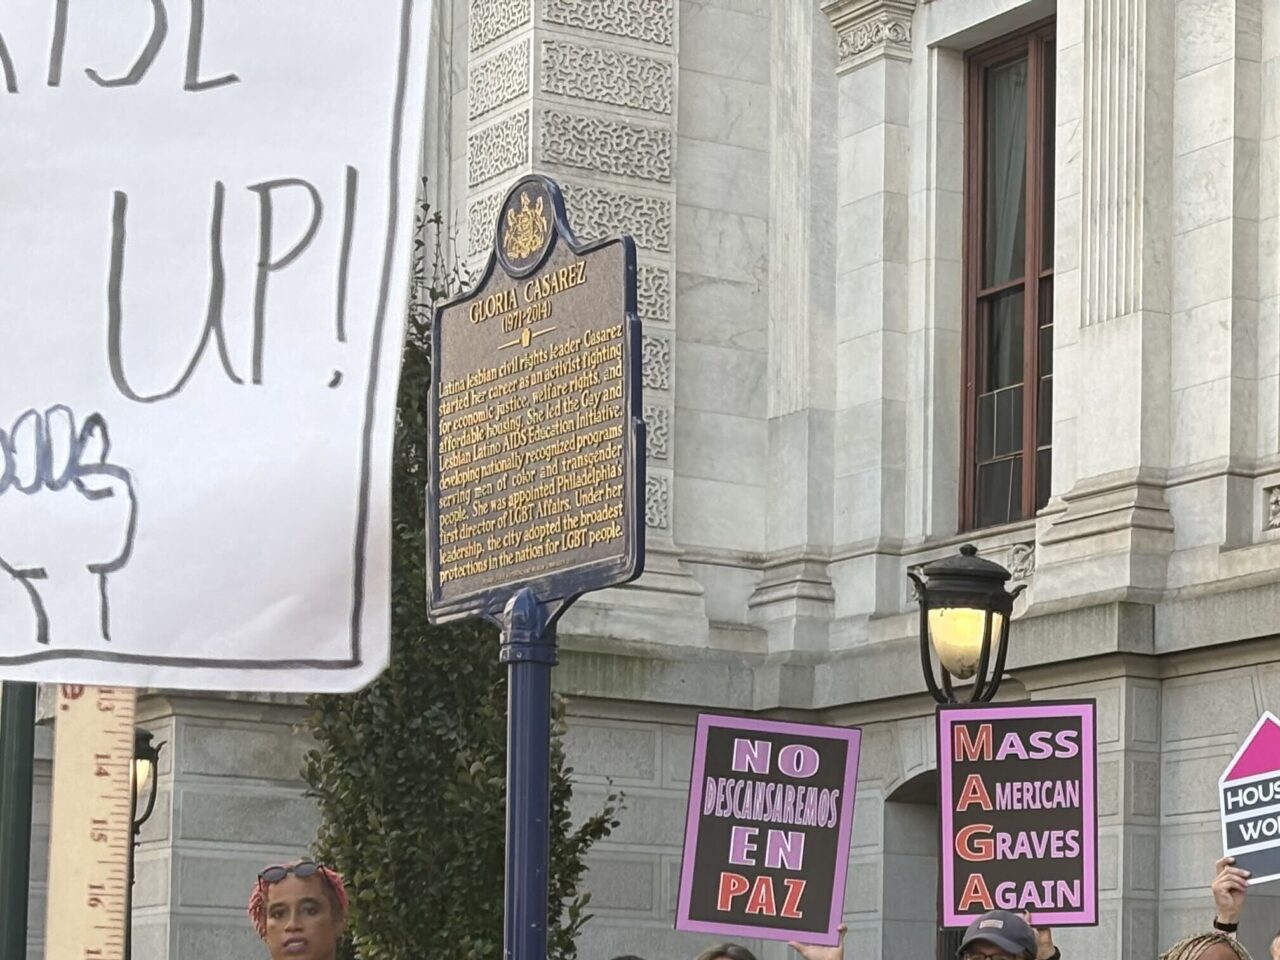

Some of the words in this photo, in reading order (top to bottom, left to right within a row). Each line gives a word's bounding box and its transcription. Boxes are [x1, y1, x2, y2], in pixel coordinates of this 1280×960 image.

[107, 164, 358, 403] UP!
[469, 288, 519, 324] GLORIA
[524, 261, 587, 303] CASAREZ
[439, 378, 465, 399] Latina
[467, 367, 497, 389] lesbian
[499, 355, 518, 378] civil
[519, 346, 548, 372] rights
[550, 336, 581, 361] leader
[584, 323, 622, 349] Casarez
[439, 391, 469, 417] started
[471, 388, 487, 406] her
[489, 378, 519, 400] career
[520, 375, 529, 390] as
[531, 370, 543, 386] an
[545, 352, 581, 382] activist
[583, 343, 622, 370] fighting
[439, 418, 452, 436] for
[453, 406, 494, 431] economic
[533, 382, 568, 406] welfare
[604, 359, 622, 383] and
[439, 425, 486, 454] affordable
[527, 406, 544, 427] She
[546, 399, 561, 421] led
[563, 395, 580, 416] the
[581, 390, 602, 410] Gay
[603, 379, 622, 403] and
[439, 450, 471, 472] Lesbian
[473, 441, 502, 462] Latino
[503, 429, 527, 453] AIDS
[529, 419, 575, 445] Education
[439, 465, 480, 489] developing
[481, 449, 525, 477] nationally
[526, 432, 576, 464] recognized
[577, 423, 623, 453] programs
[439, 488, 471, 509] serving
[474, 482, 493, 499] men
[497, 473, 508, 492] of
[512, 467, 536, 488] color
[540, 458, 558, 480] and
[562, 443, 623, 474] transgender
[472, 498, 489, 517] She
[490, 496, 507, 513] was
[508, 478, 555, 510] appointed
[440, 523, 460, 545] first
[460, 516, 496, 539] director
[497, 510, 509, 530] of
[509, 503, 535, 527] LGBT
[575, 487, 605, 510] Under
[606, 482, 623, 501] her
[487, 534, 502, 552] the
[503, 528, 523, 549] city
[524, 517, 561, 543] adopted
[563, 513, 580, 533] the
[580, 501, 623, 529] broadest
[440, 558, 488, 586] protections
[489, 556, 498, 570] in
[498, 549, 514, 568] the
[515, 544, 544, 564] nation
[545, 538, 560, 556] for
[561, 529, 588, 553] LGBT
[732, 738, 819, 778] NO
[954, 723, 1079, 762] MASS
[704, 777, 839, 828] DESCANSAREMOS
[956, 774, 1080, 812] AMERICAN
[729, 825, 805, 871] EN
[955, 824, 1080, 862] GRAVES
[717, 872, 806, 919] PAZ
[958, 873, 1081, 911] AGAIN
